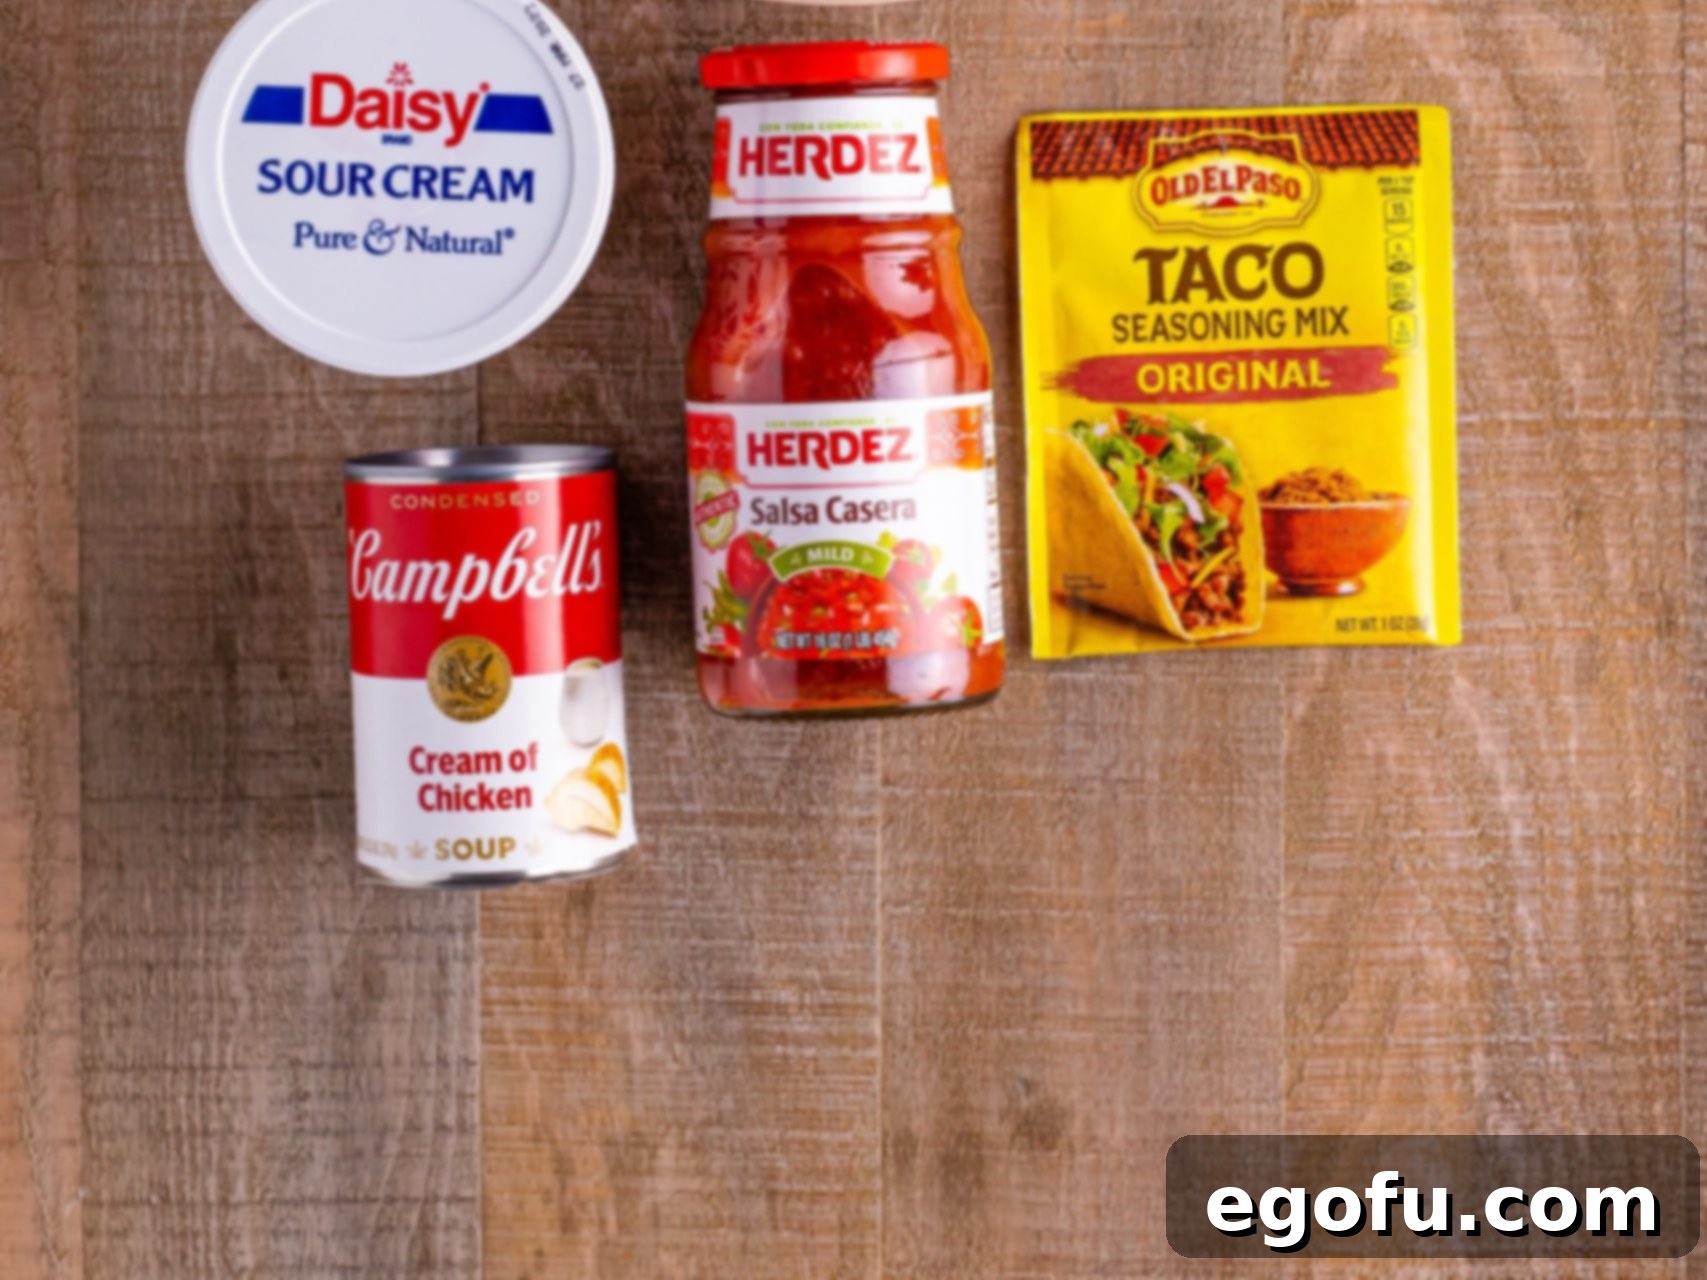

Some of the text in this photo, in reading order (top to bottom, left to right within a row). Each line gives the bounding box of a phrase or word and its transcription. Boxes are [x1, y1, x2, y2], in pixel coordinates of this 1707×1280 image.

[309, 70, 480, 148] Daisy
[738, 134, 922, 181] HERDEZ
[257, 158, 535, 205] SOUR CREAM
[293, 221, 358, 250] Pure
[363, 218, 401, 256] &
[1133, 240, 1325, 305] TACO
[1112, 305, 1350, 345] SEASONING MIX
[1136, 358, 1332, 394] ORIGINAL
[746, 427, 914, 470] HERDEZ
[389, 489, 541, 510] CONDENSED
[750, 496, 819, 526] Salsa
[825, 495, 917, 525] Casera
[349, 519, 603, 620] Campbell's
[806, 547, 855, 563] MILD
[408, 740, 539, 775] Cream of
[417, 782, 533, 813] Chicken
[434, 836, 517, 861] SOUP
